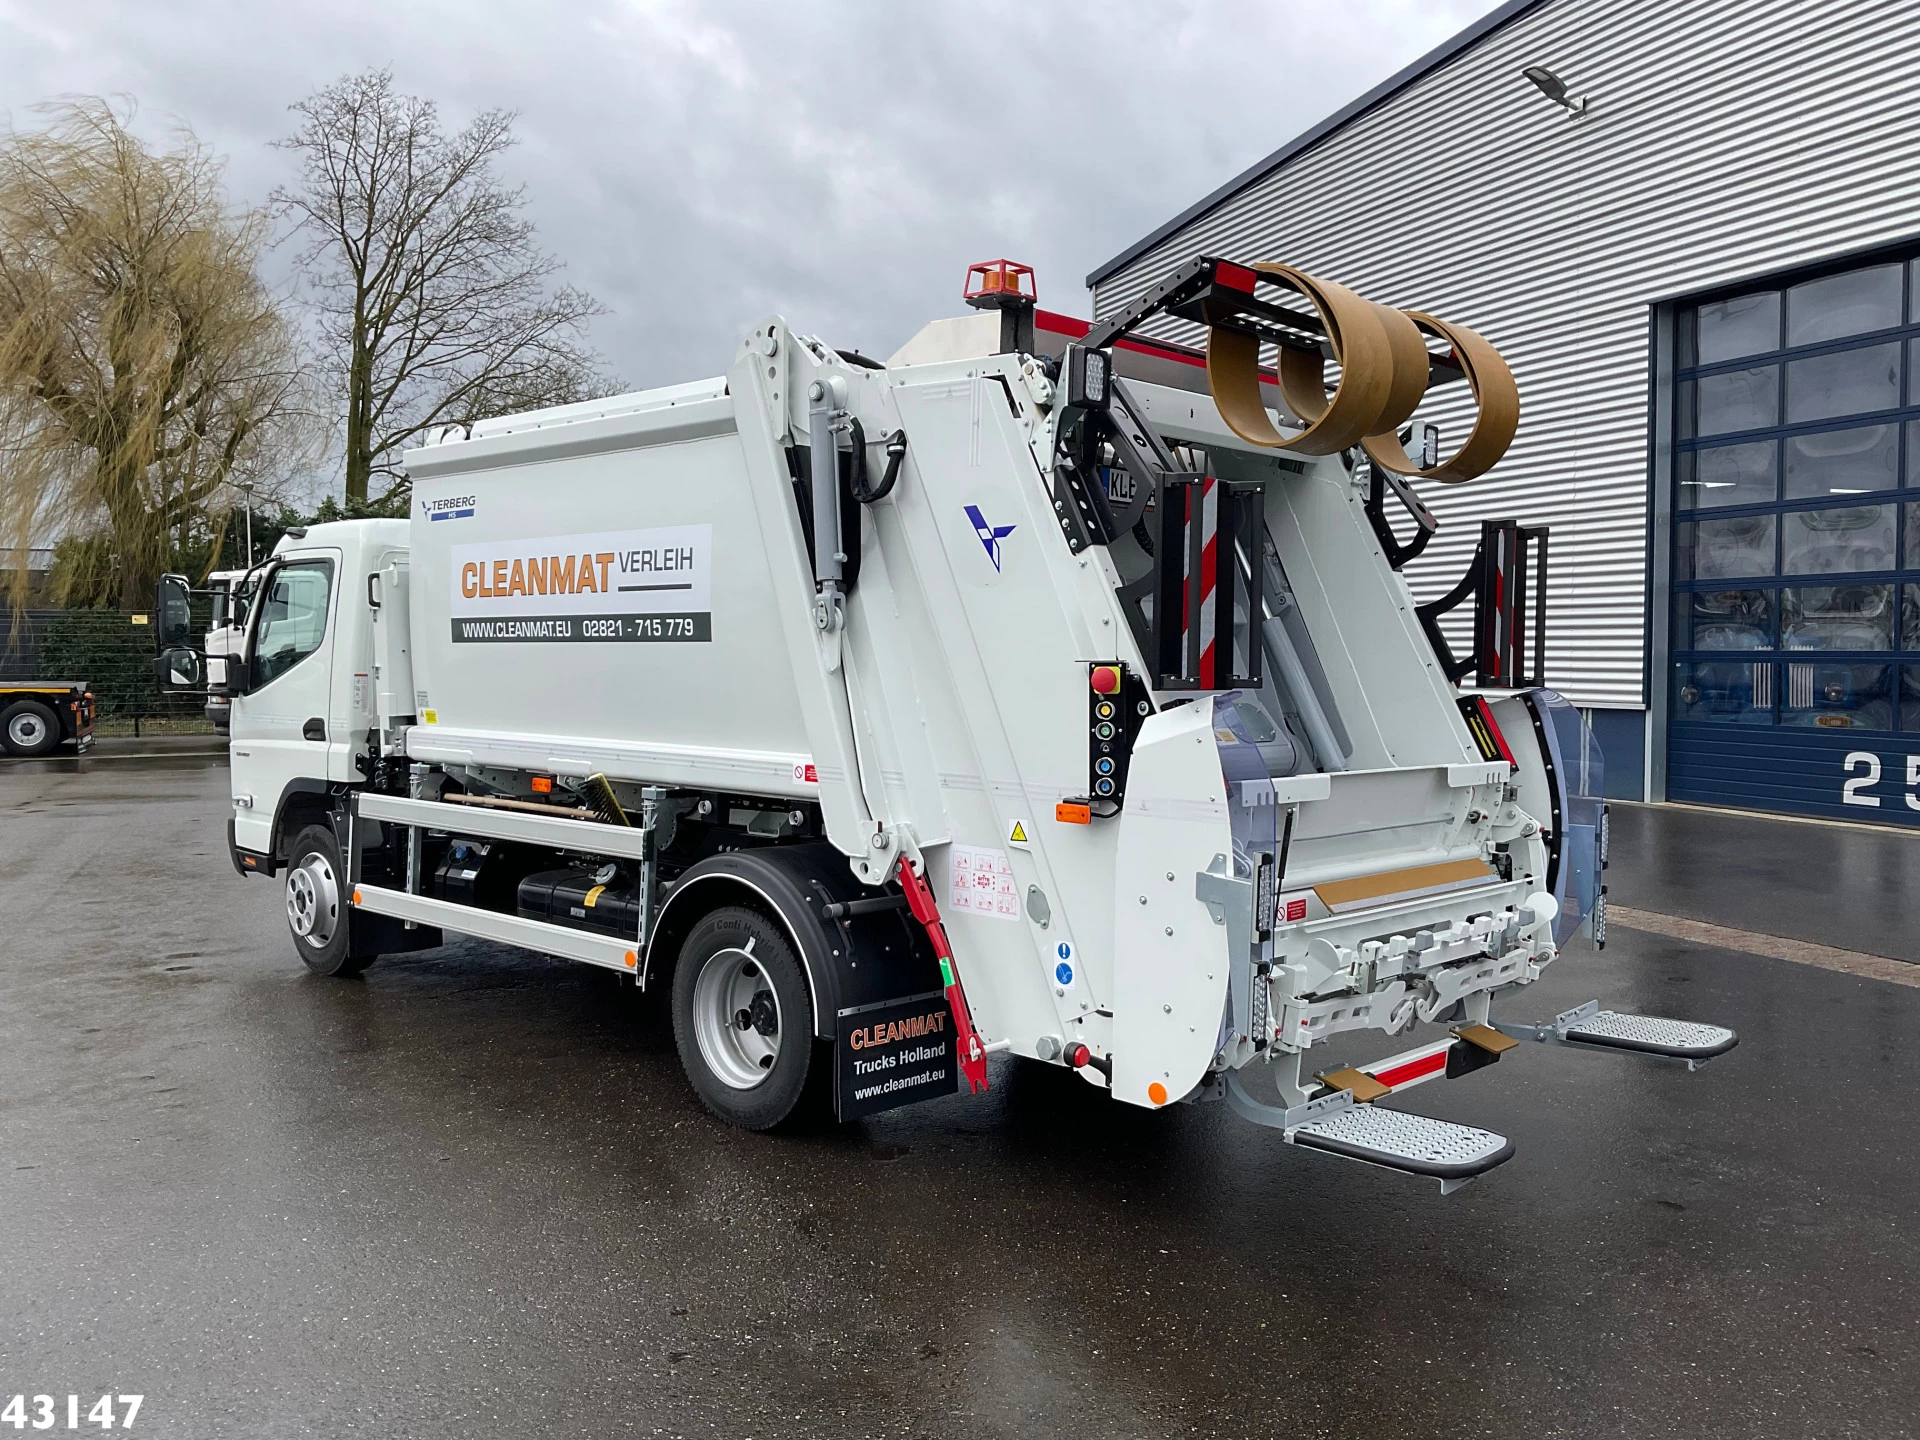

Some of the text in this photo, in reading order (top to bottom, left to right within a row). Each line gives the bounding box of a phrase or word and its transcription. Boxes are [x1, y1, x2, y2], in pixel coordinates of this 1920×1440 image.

[432, 495, 476, 511] TERBERG
[448, 511, 457, 519] HS
[461, 547, 693, 599] CLEANMAT VERLEIH
[462, 620, 572, 638] WWW.CLEANMAT.EU
[582, 619, 623, 637] 02821
[635, 619, 662, 637] 715
[665, 618, 694, 637] 779
[850, 1011, 946, 1050] CLEANMAT
[854, 1041, 946, 1075] Trucks Holland
[854, 1069, 945, 1100] www.cleanmat.eu
